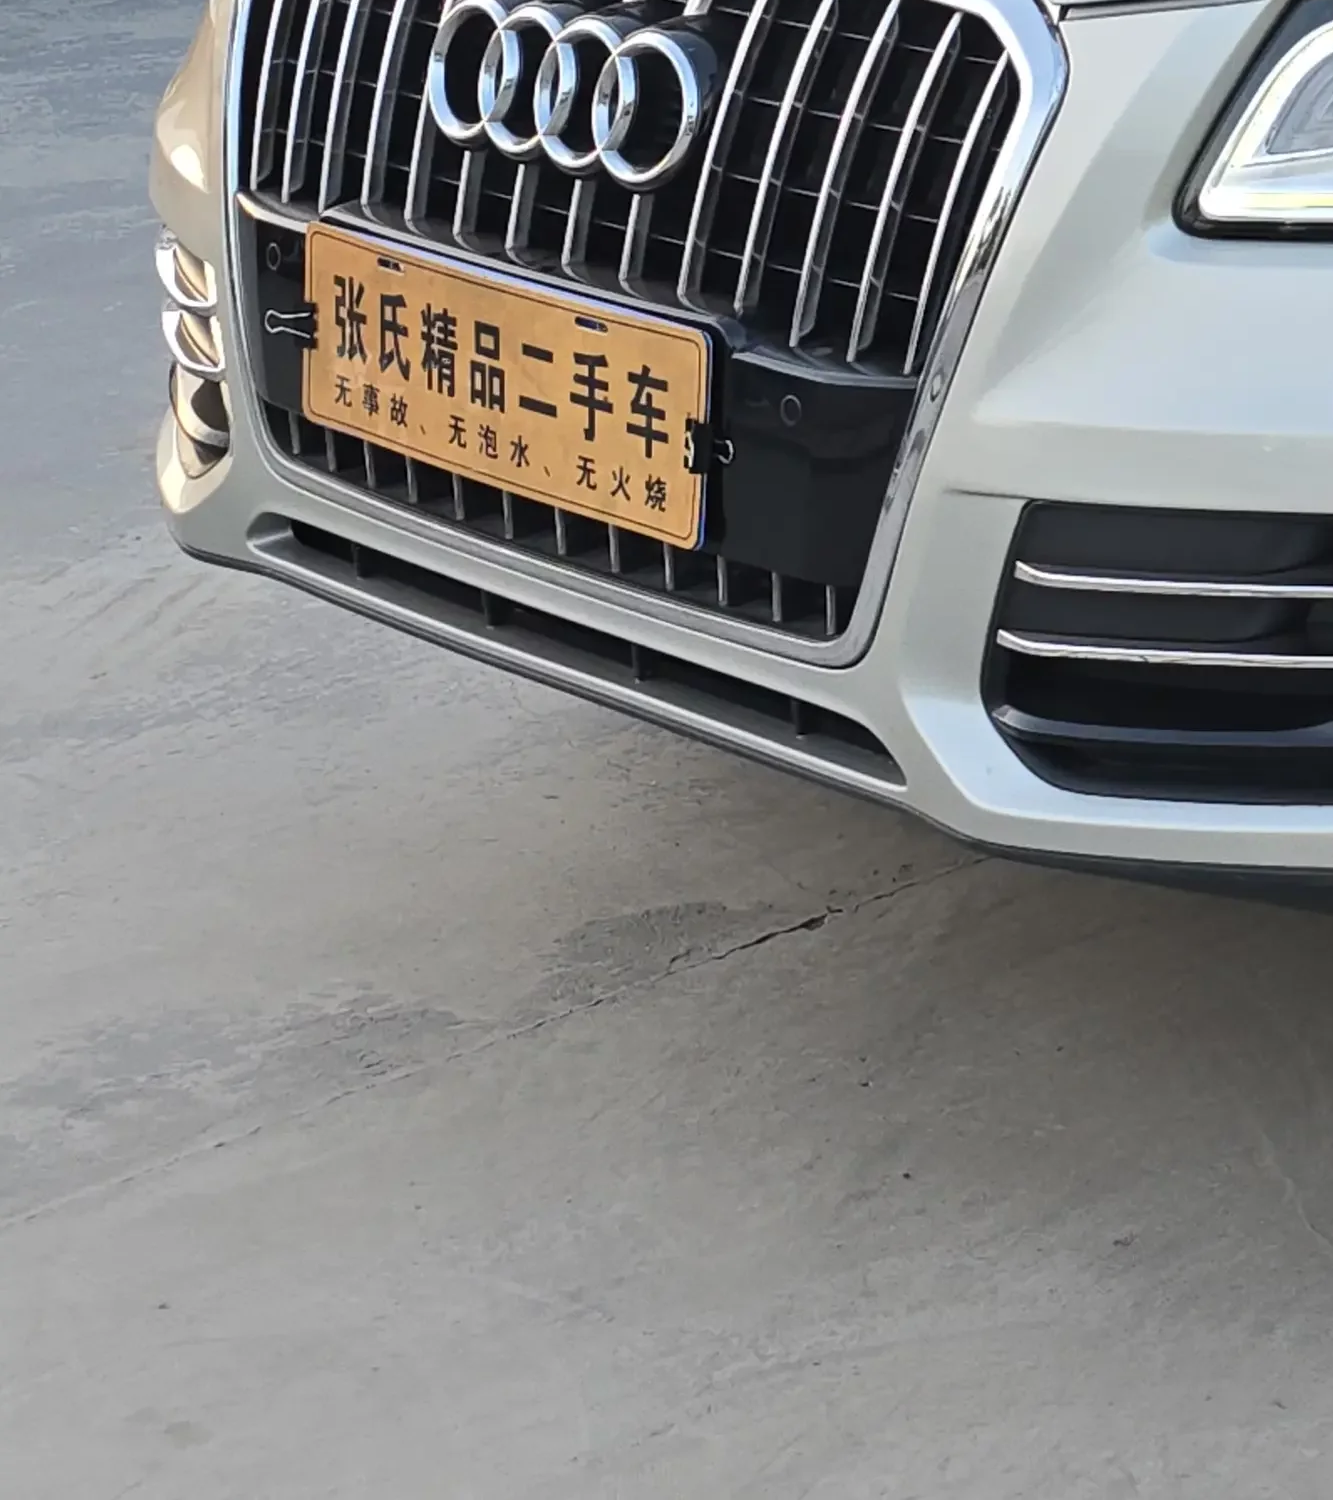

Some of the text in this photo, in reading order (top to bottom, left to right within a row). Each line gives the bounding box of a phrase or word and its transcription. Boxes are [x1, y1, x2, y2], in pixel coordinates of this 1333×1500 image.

[333, 273, 672, 460] 张氏精品二手车
[333, 374, 668, 513] 无事故、无泡水、无火烧
